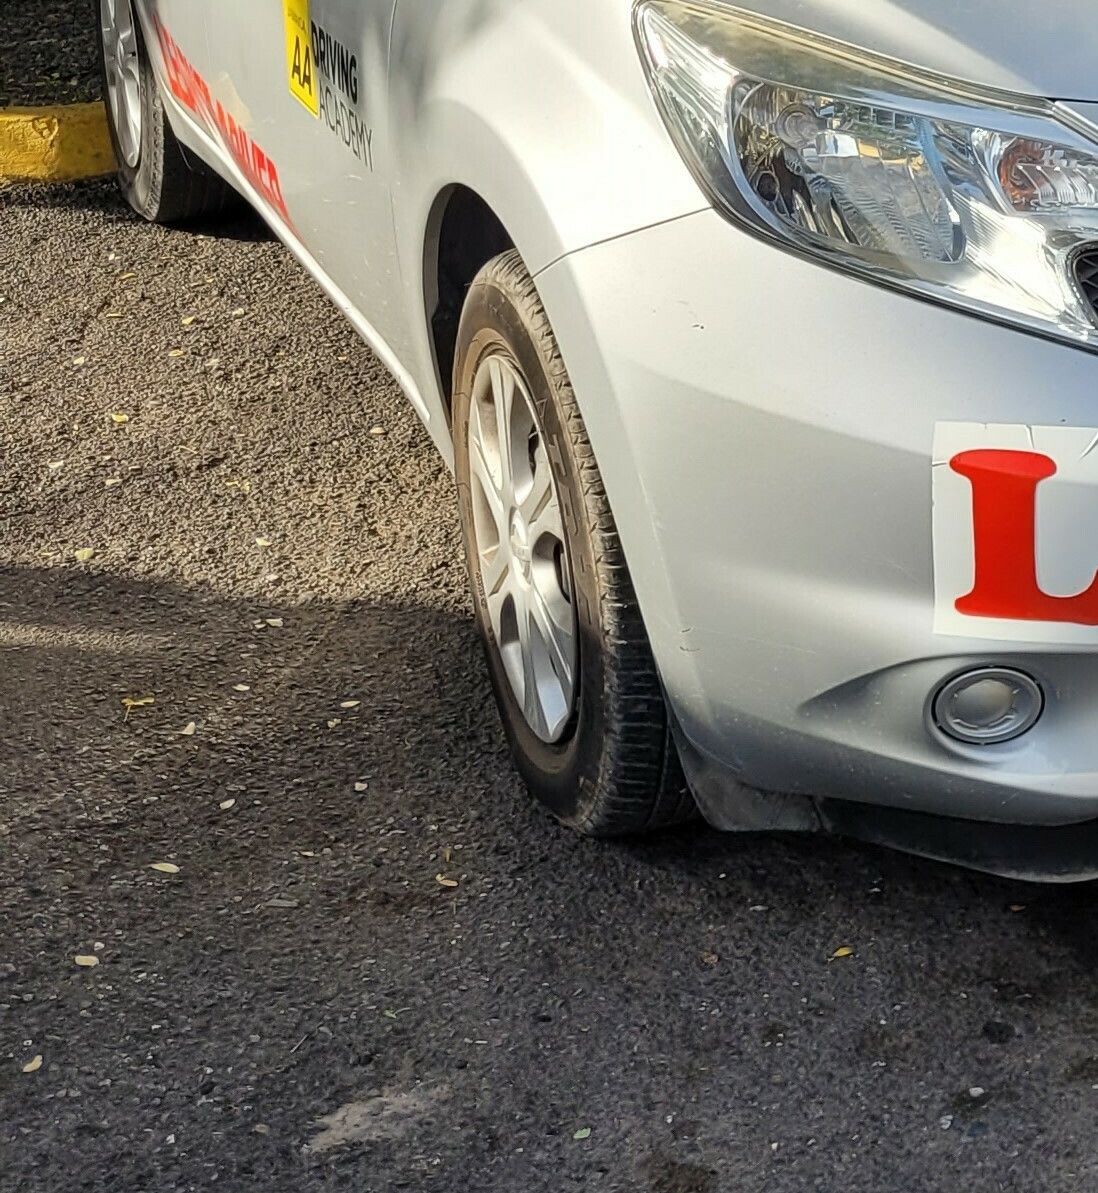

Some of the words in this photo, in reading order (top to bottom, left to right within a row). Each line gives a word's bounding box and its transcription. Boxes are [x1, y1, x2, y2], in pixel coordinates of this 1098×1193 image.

[291, 35, 313, 97] AA
[311, 19, 359, 106] DRIVING
[318, 79, 374, 173] ACADEMY
